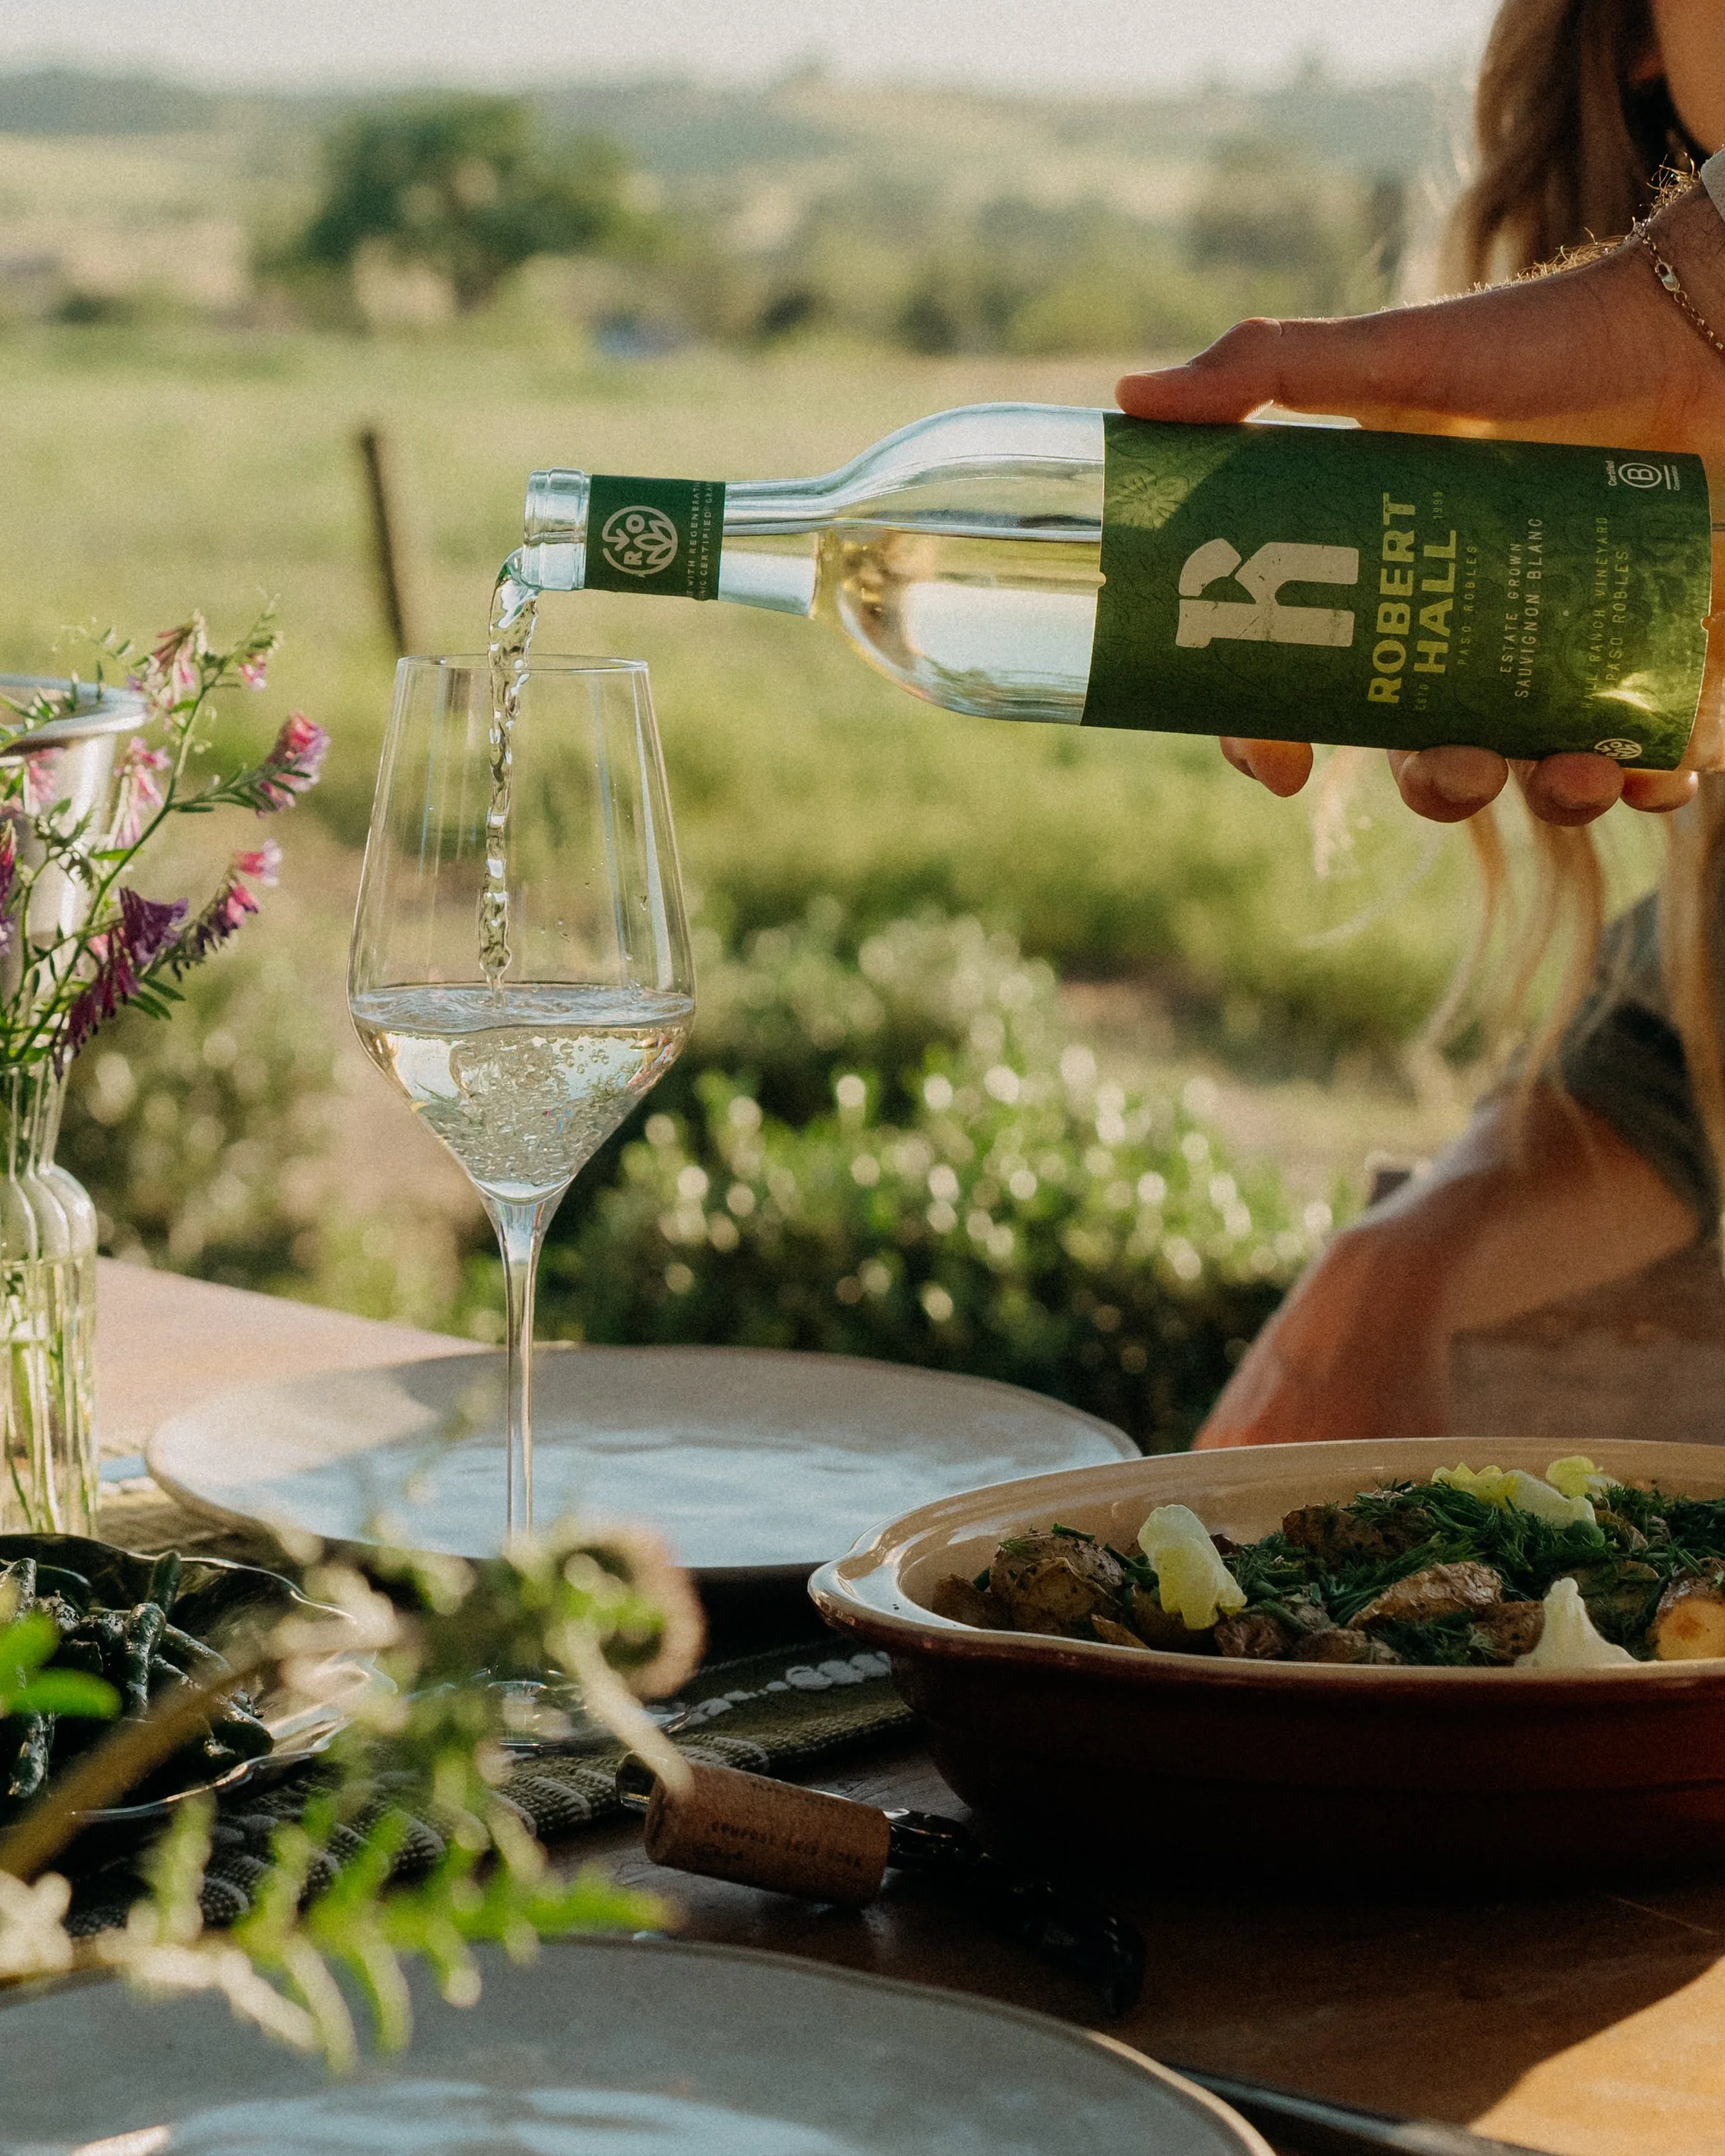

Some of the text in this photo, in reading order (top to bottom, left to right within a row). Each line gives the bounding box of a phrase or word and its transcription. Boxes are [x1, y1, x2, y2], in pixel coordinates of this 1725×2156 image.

[1432, 491, 1444, 520] 1999
[1605, 460, 1617, 487] Certified
[686, 560, 696, 586] WITH
[1367, 492, 1416, 704] ROBERT
[1413, 529, 1457, 673] HALL
[1458, 546, 1478, 665] PASO ROBLES
[1499, 543, 1522, 673] ESTATE GROWN
[1514, 518, 1543, 699] SAUVIGNON BLANC
[1581, 517, 1609, 709] HALL RANCH VINEYARD
[1606, 550, 1629, 681] PASO ROBLES
